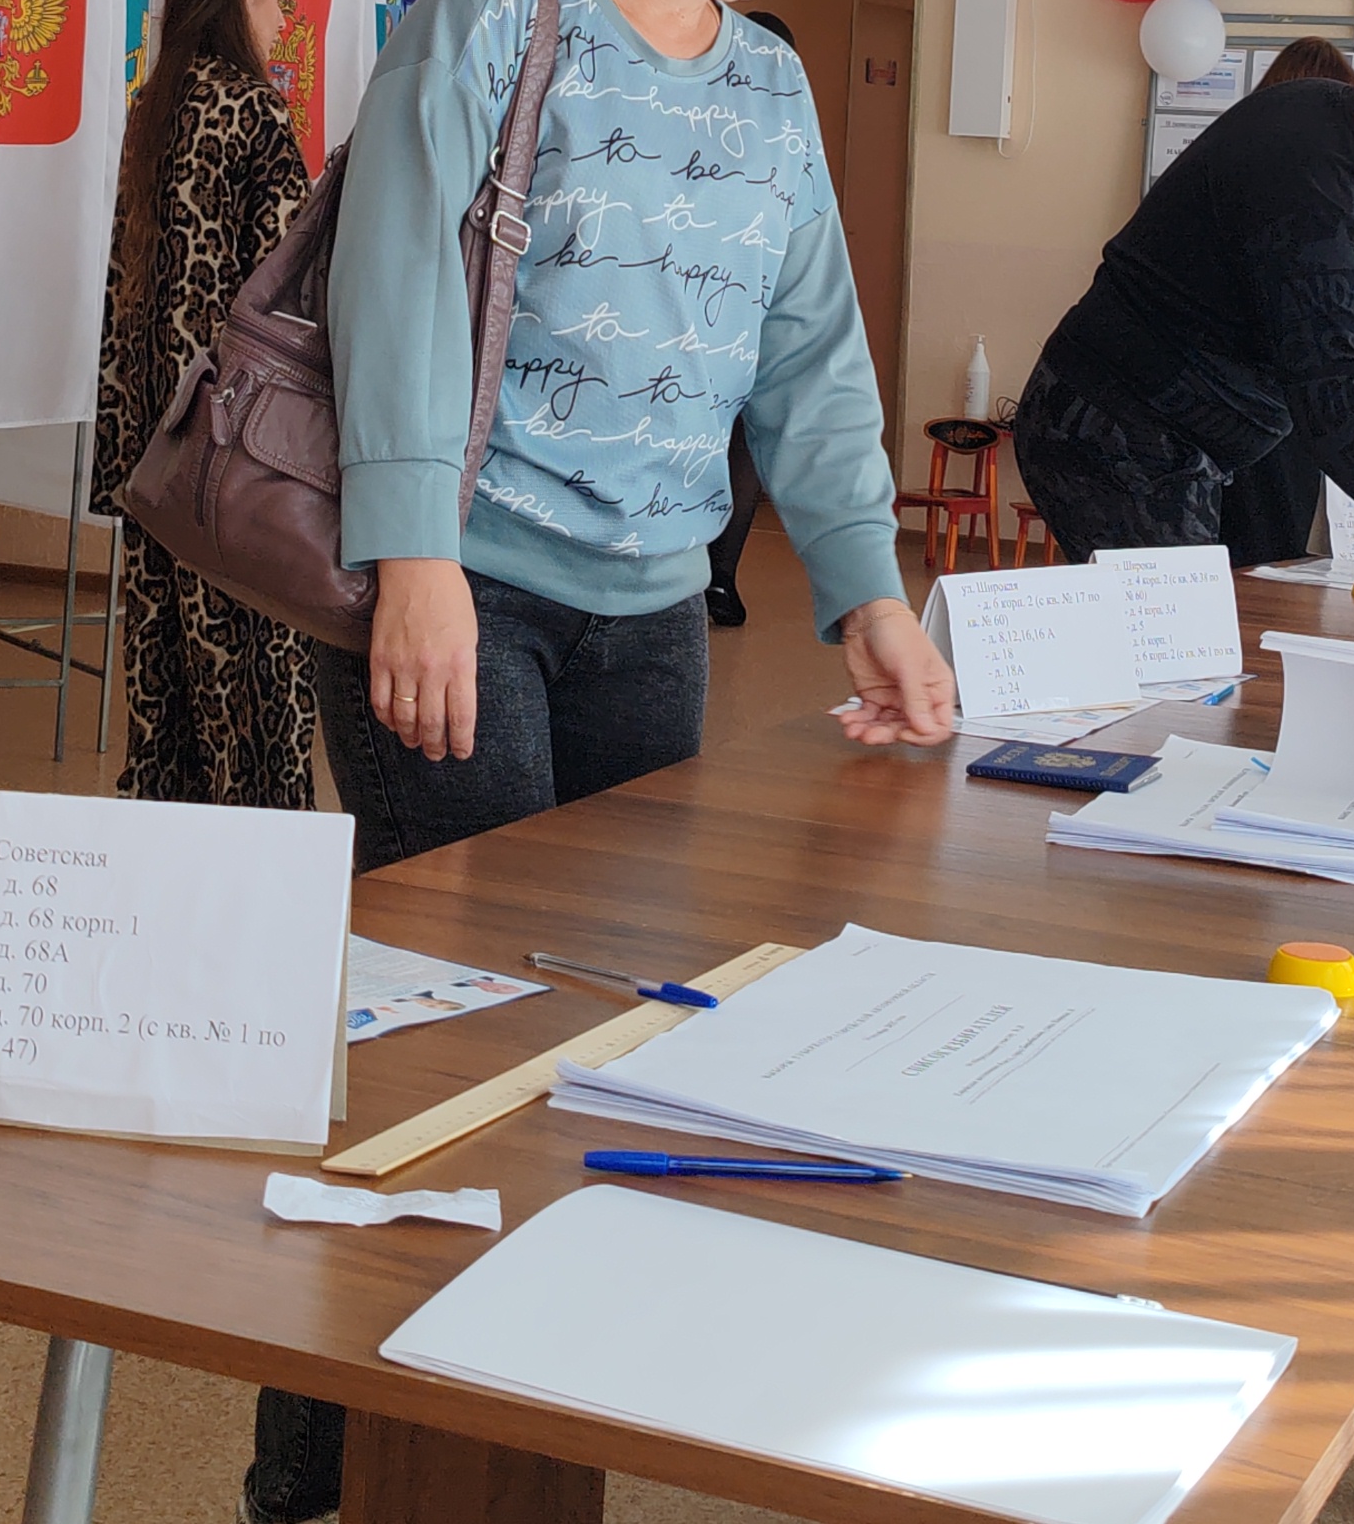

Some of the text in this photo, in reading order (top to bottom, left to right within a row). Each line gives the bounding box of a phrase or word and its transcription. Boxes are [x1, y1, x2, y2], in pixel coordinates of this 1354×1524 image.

[547, 65, 621, 99] be
[621, 87, 758, 158] happy
[571, 127, 661, 166] to
[670, 150, 745, 181] be
[525, 185, 632, 250] appy
[643, 195, 717, 229] to
[534, 234, 619, 269] be
[552, 303, 649, 340] to
[506, 356, 706, 420] appy to
[503, 403, 727, 489] be happy
[476, 477, 571, 537] appy
[961, 581, 1019, 597] ул. Широкая
[1027, 595, 1034, 607] 2
[1062, 592, 1073, 604] №
[1075, 591, 1086, 604] 17
[1088, 592, 1100, 603] по
[993, 614, 1009, 627] 60)
[1003, 647, 1014, 660] 18
[1006, 664, 1025, 677] 18А
[1008, 681, 1020, 693] 24
[1011, 698, 1030, 711] 24А
[3, 879, 23, 896] д.
[32, 875, 59, 897] 68
[0, 910, 19, 928] д.
[28, 907, 54, 929] 68
[62, 915, 120, 938] корп.
[131, 915, 139, 936] 1
[24, 940, 69, 963] 68А
[21, 972, 48, 994] 70
[18, 1005, 44, 1027] 70
[51, 1013, 109, 1036] корп.
[118, 1013, 130, 1034] 2
[138, 1014, 159, 1042] (с
[166, 1022, 196, 1040] кв.
[204, 1020, 231, 1043] №
[241, 1023, 248, 1044] 1
[258, 1029, 286, 1047] по
[945, 1005, 1013, 1053] ИЗБИРАТЕЛЕЙ
[1, 1037, 38, 1065] 47)
